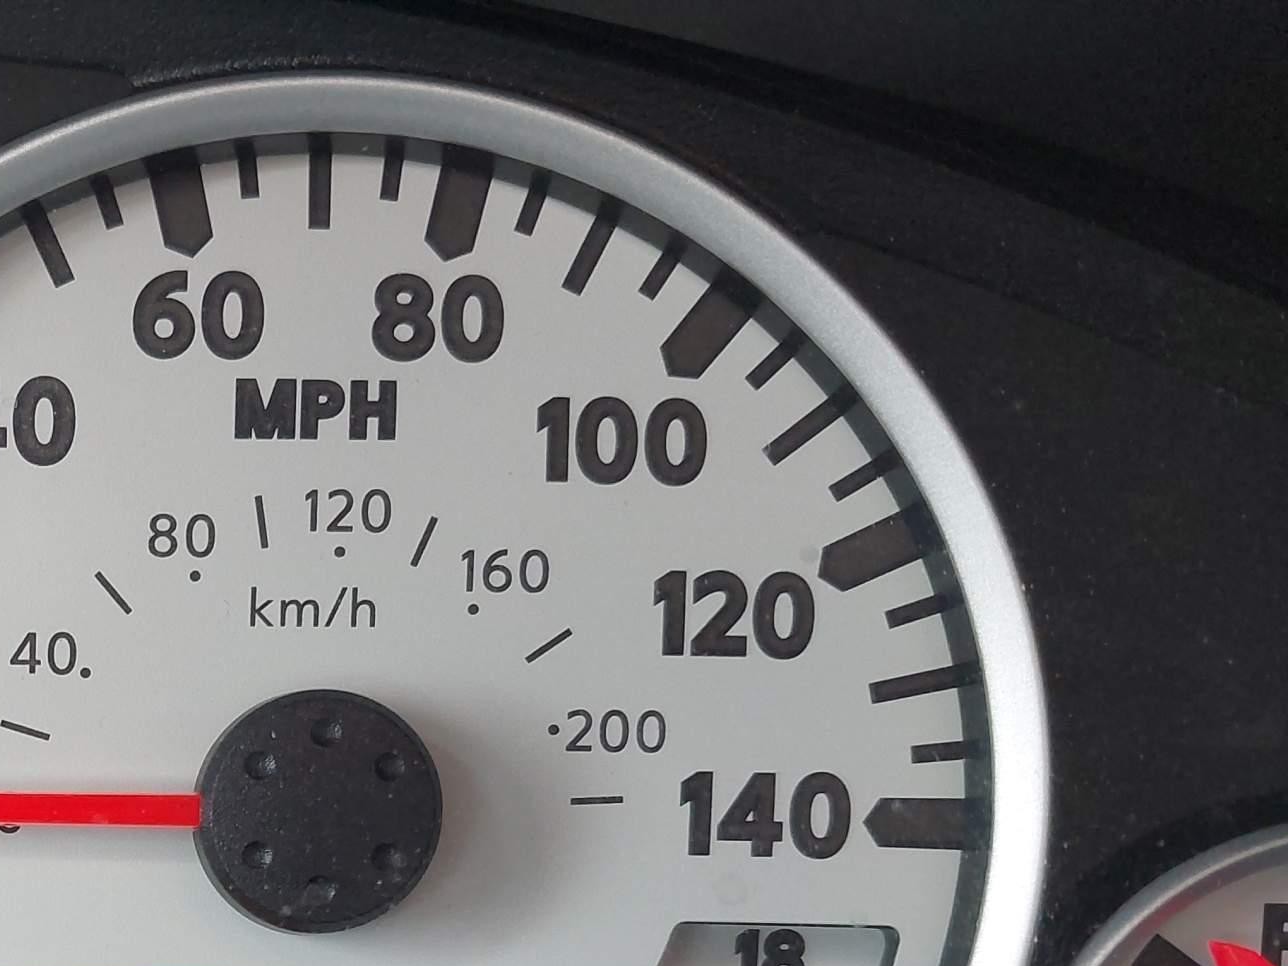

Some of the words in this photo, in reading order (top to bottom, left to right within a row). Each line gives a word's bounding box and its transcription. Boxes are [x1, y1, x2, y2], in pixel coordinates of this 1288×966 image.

[133, 270, 265, 361] 60
[372, 273, 504, 363] 80
[234, 378, 397, 440] MPH
[536, 396, 707, 486] 100
[148, 513, 216, 558] 80
[304, 489, 392, 533] 120
[461, 549, 550, 593] 160
[248, 586, 376, 629] km/h
[653, 569, 815, 659] 120
[10, 632, 77, 676] 40
[565, 709, 666, 753] 200
[679, 770, 851, 859] 140
